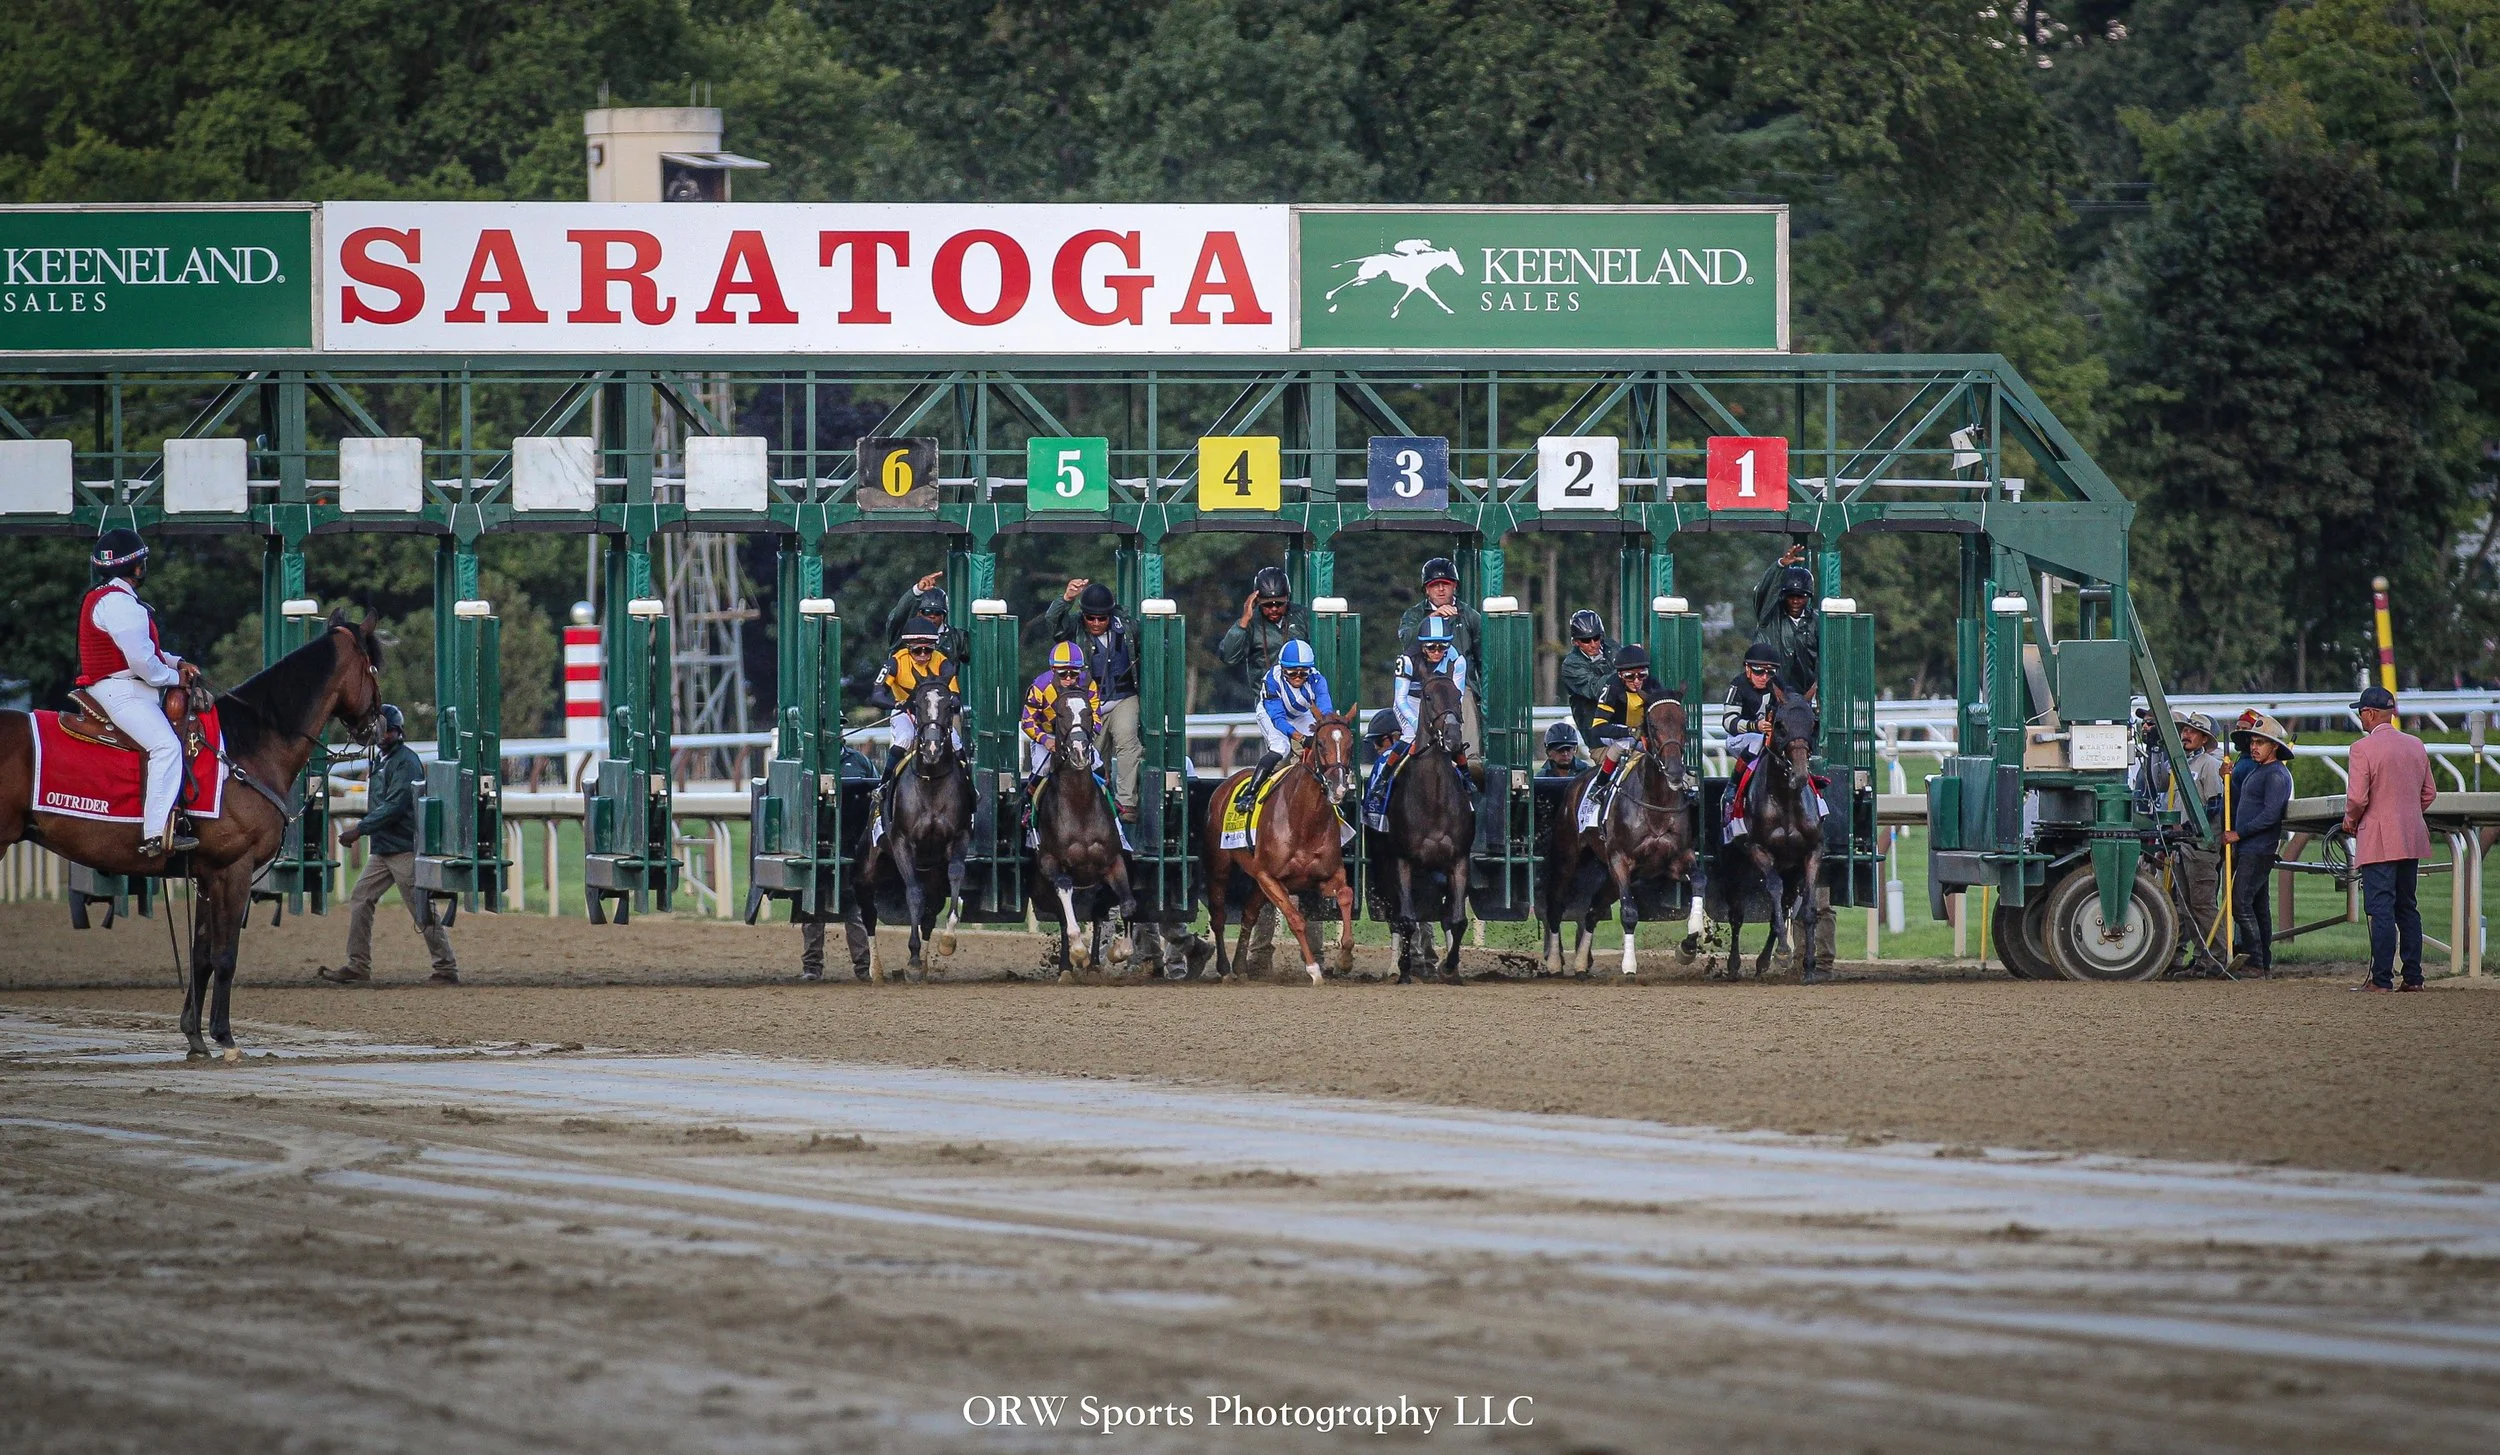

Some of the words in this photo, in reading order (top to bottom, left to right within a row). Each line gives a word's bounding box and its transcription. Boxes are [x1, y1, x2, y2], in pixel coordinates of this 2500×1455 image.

[341, 227, 1272, 326] SARATOGA
[4, 292, 107, 312] SALES
[1480, 291, 1580, 312] SALES
[881, 448, 914, 498] 6
[1054, 449, 1086, 498] 5
[1222, 449, 1254, 497] 4
[1394, 449, 1425, 498] 3
[1564, 450, 1594, 498] 2
[1734, 449, 1757, 498] 1
[875, 667, 888, 684] 6
[1394, 658, 1404, 676] 3
[1598, 686, 1608, 703] 2
[46, 791, 109, 813] OUTRIDER
